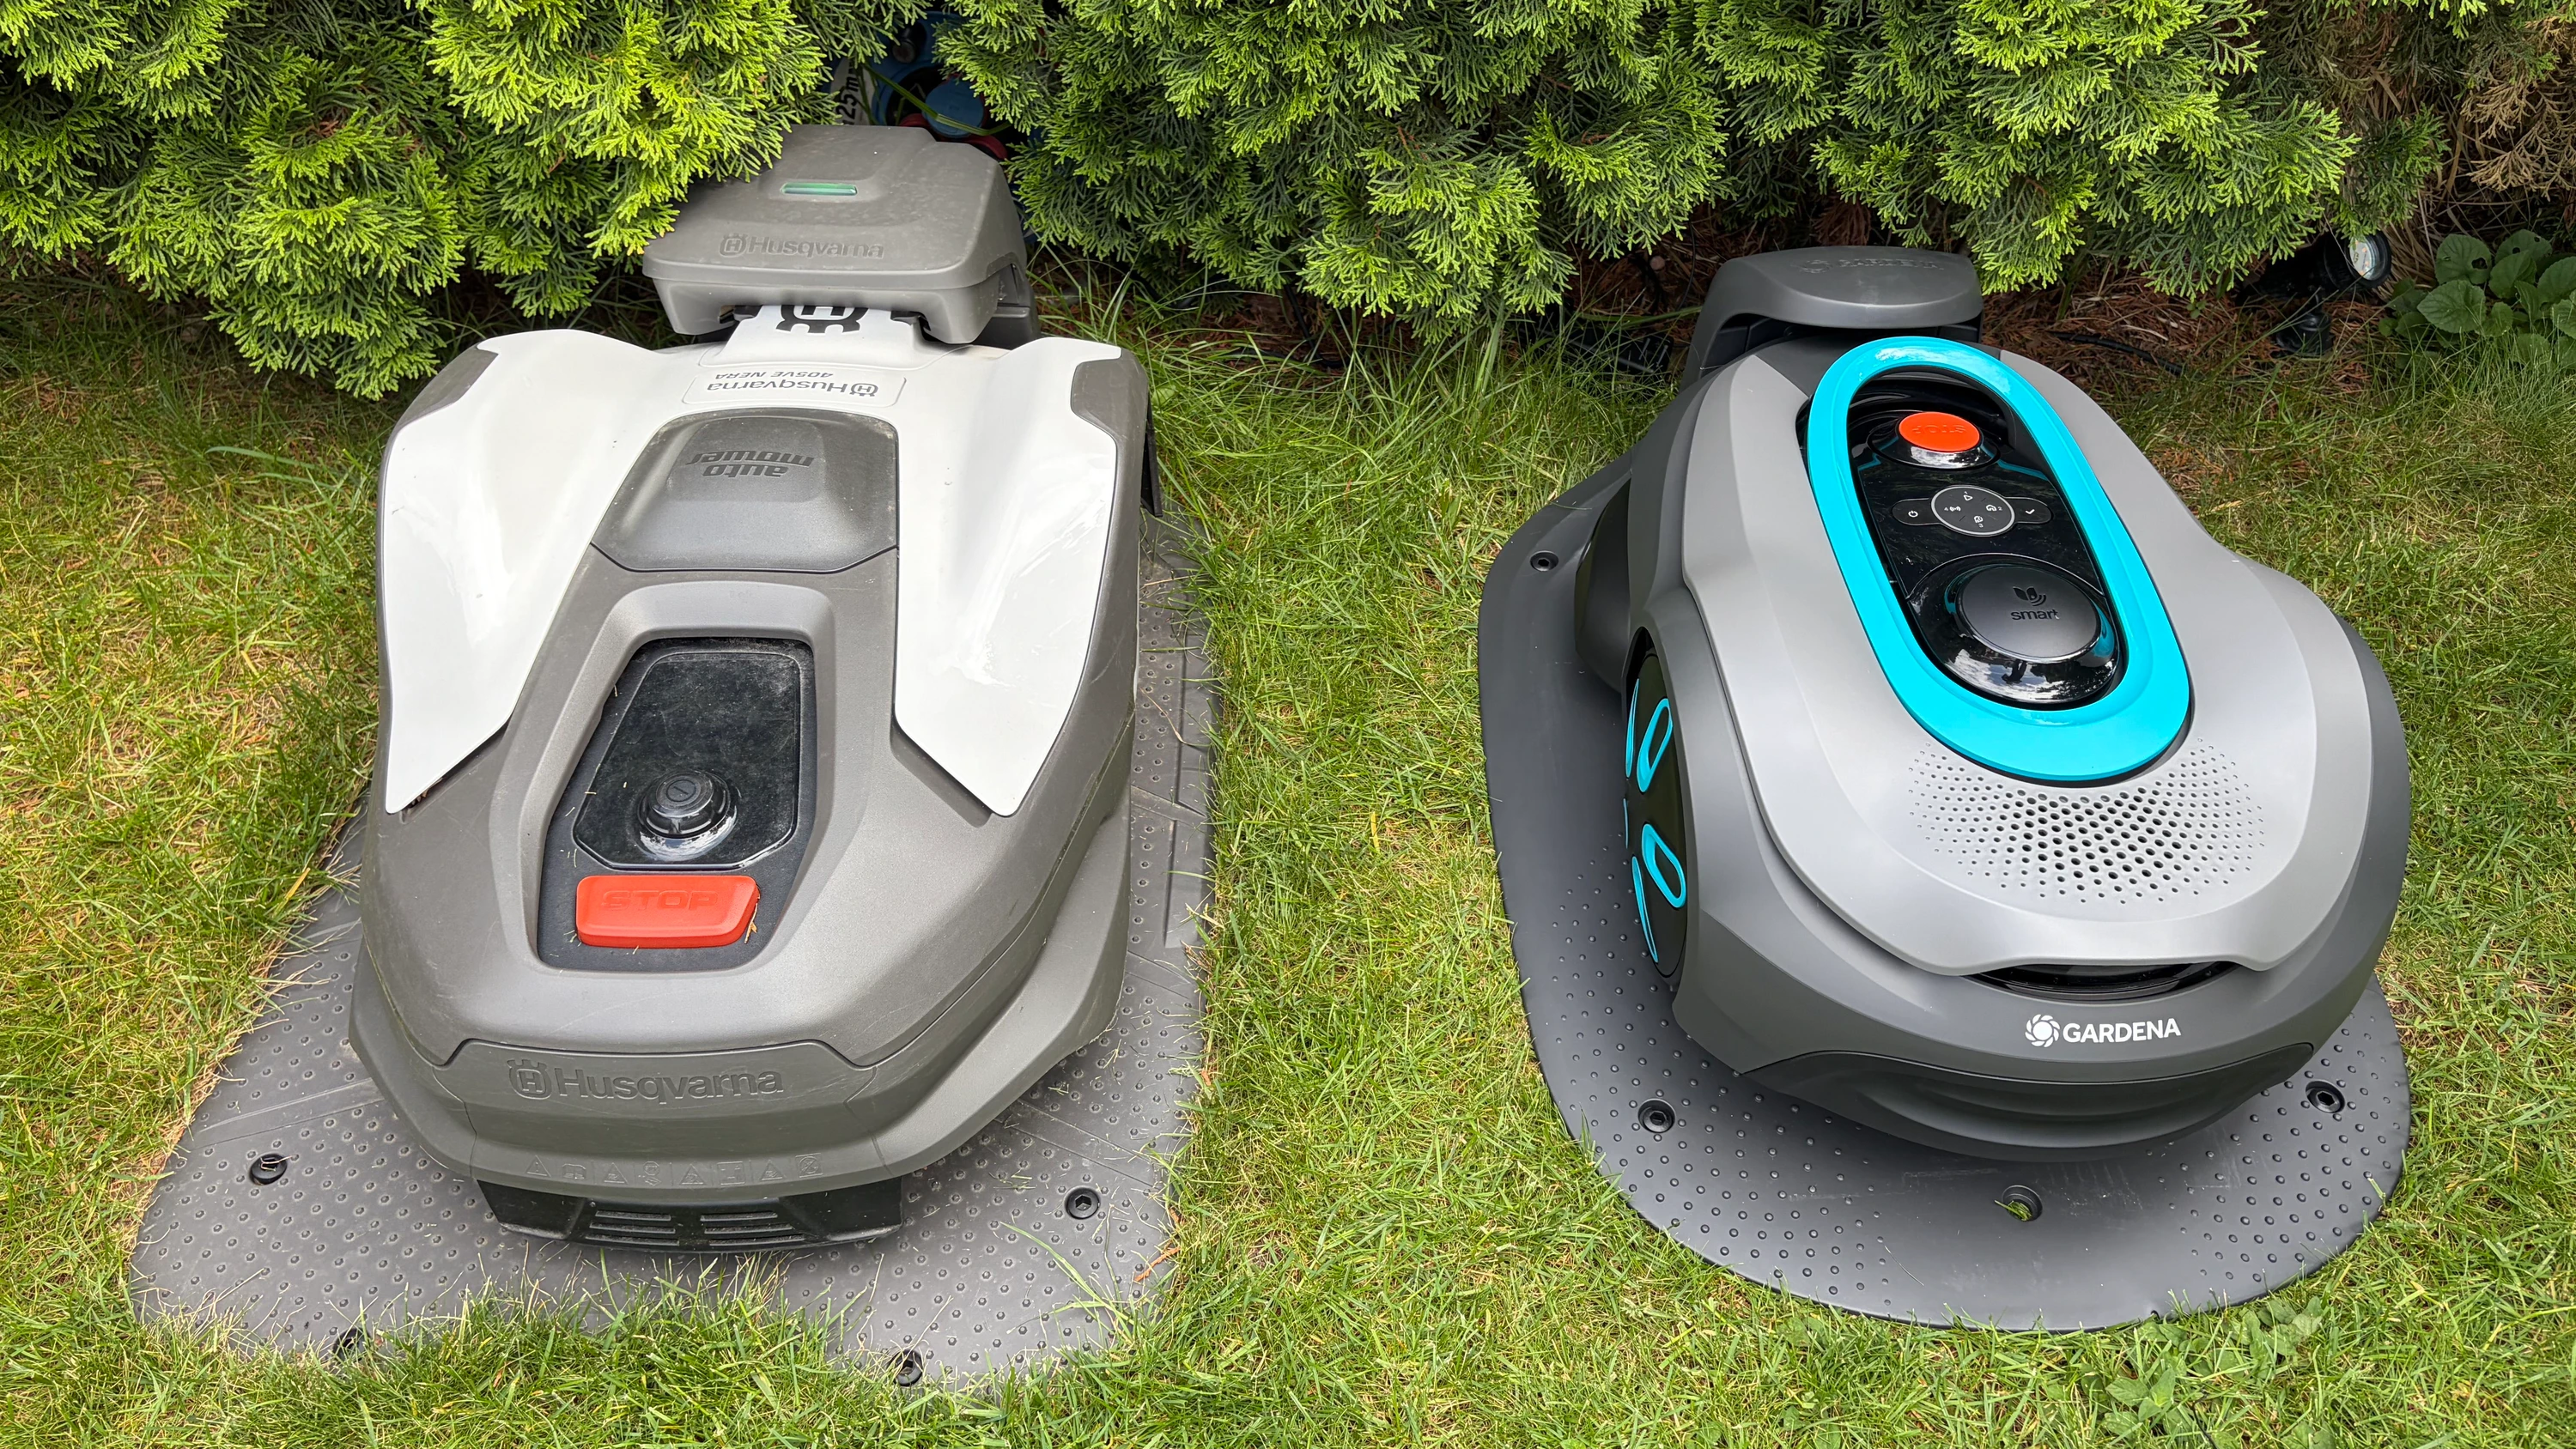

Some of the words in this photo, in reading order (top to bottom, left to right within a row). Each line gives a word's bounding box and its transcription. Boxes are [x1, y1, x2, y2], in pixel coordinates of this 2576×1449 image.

[748, 236, 885, 259] Husqvarna
[715, 371, 767, 379] NERA
[707, 379, 848, 393] Husqvarna
[686, 450, 815, 467] mower
[702, 464, 789, 478] auto
[2010, 608, 2060, 621] smart
[602, 889, 719, 911] STOP
[2063, 1018, 2182, 1044] GARDENA
[554, 1067, 784, 1105] Husqvarna
